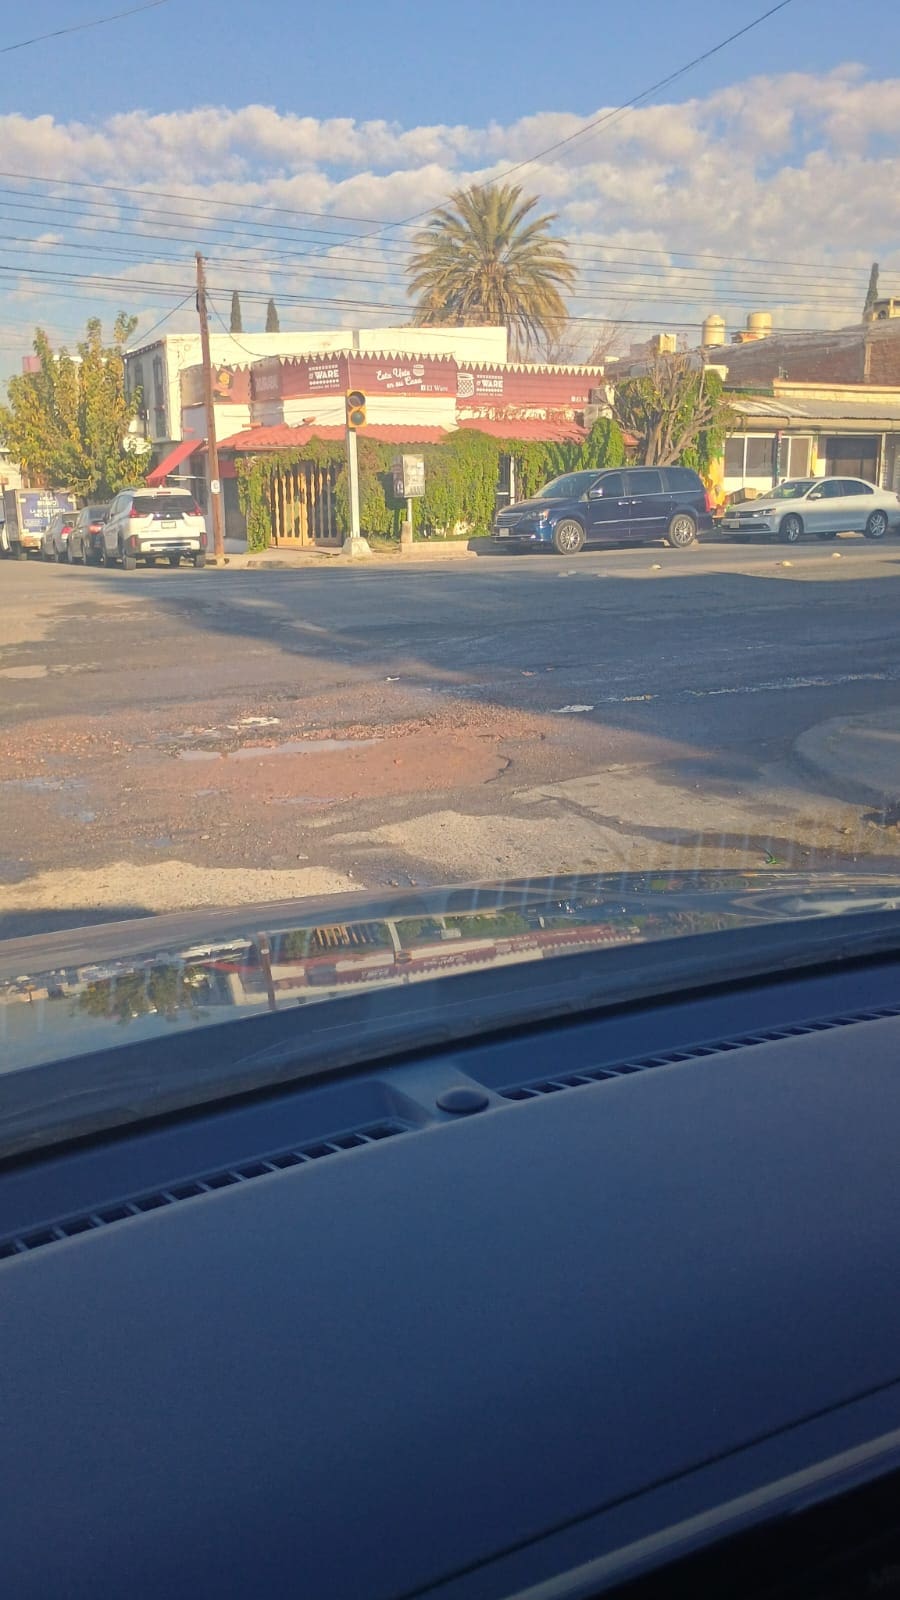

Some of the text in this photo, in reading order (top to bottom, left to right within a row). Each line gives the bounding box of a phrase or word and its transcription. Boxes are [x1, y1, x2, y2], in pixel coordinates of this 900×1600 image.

[314, 369, 340, 379] WARE
[404, 376, 423, 386] Casa
[482, 380, 503, 388] WARE
